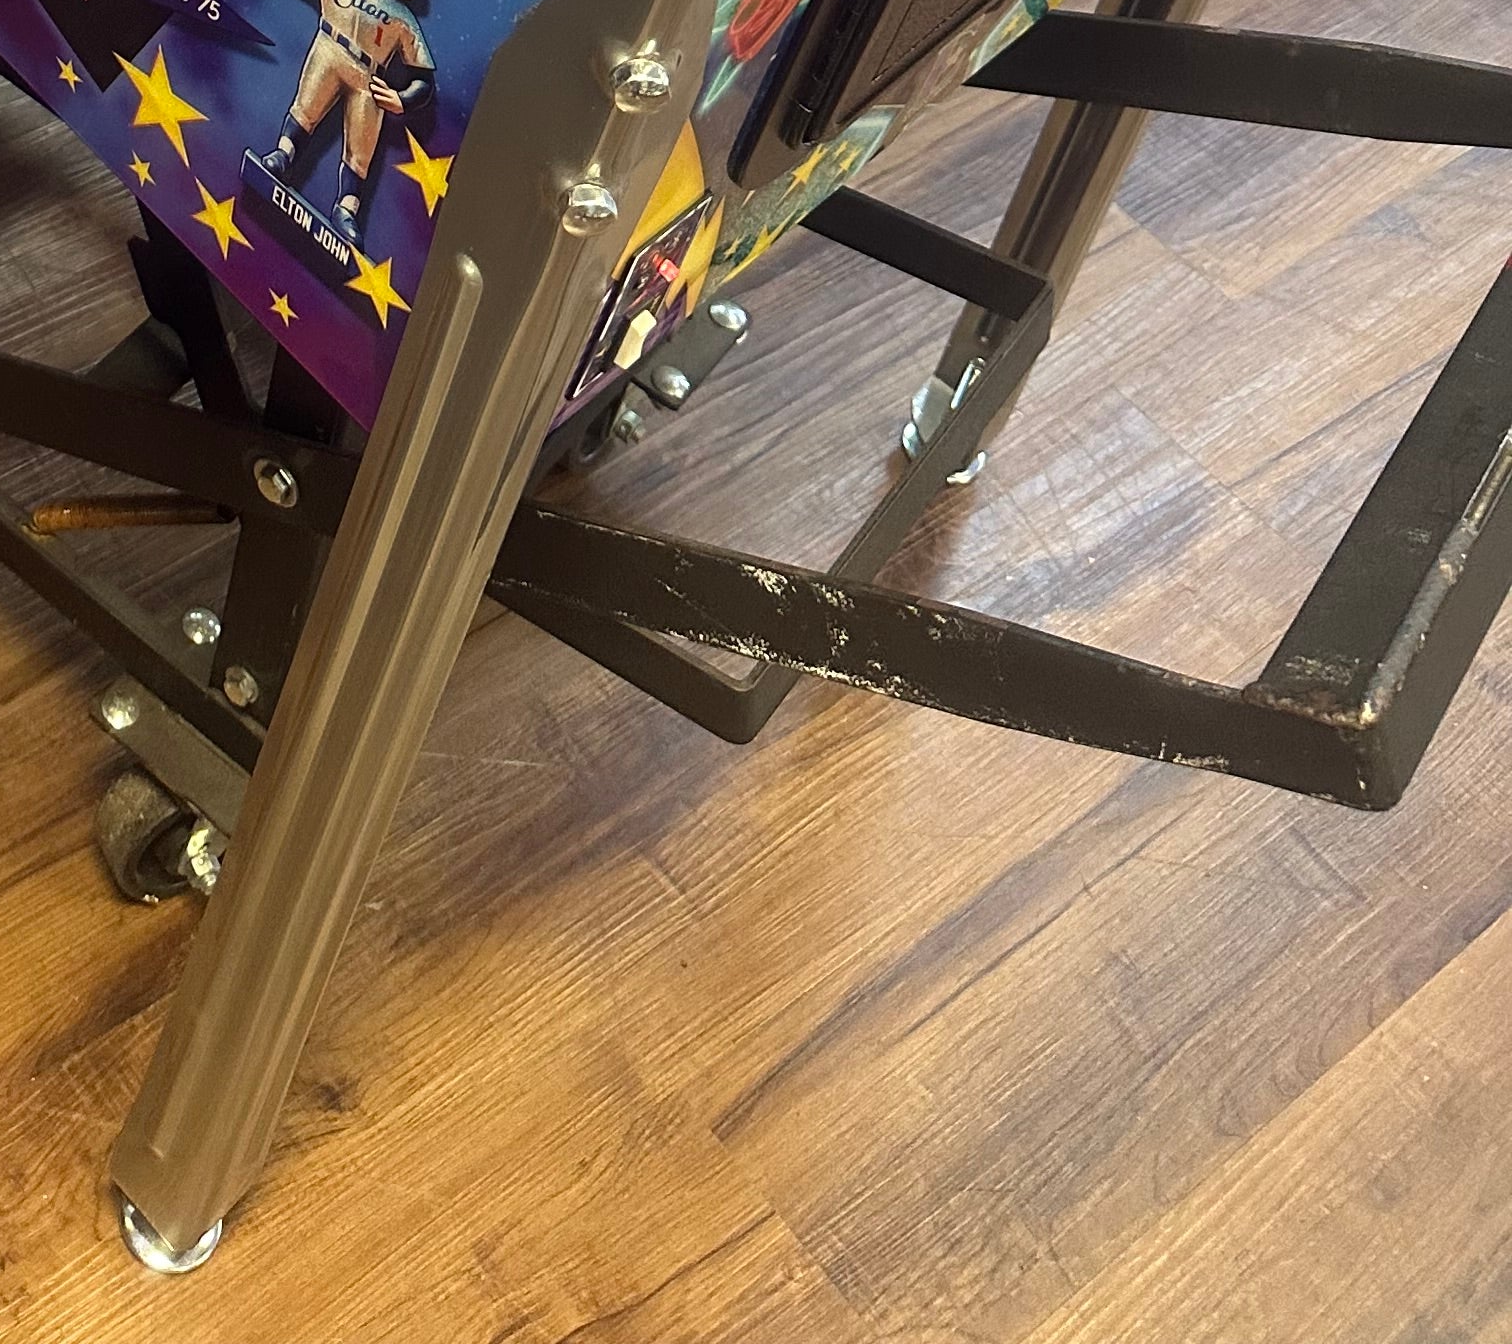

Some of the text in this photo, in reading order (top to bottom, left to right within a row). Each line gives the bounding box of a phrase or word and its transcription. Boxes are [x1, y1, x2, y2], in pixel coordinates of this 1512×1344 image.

[373, 24, 385, 48] 1
[271, 184, 352, 268] ELTON JOHN
